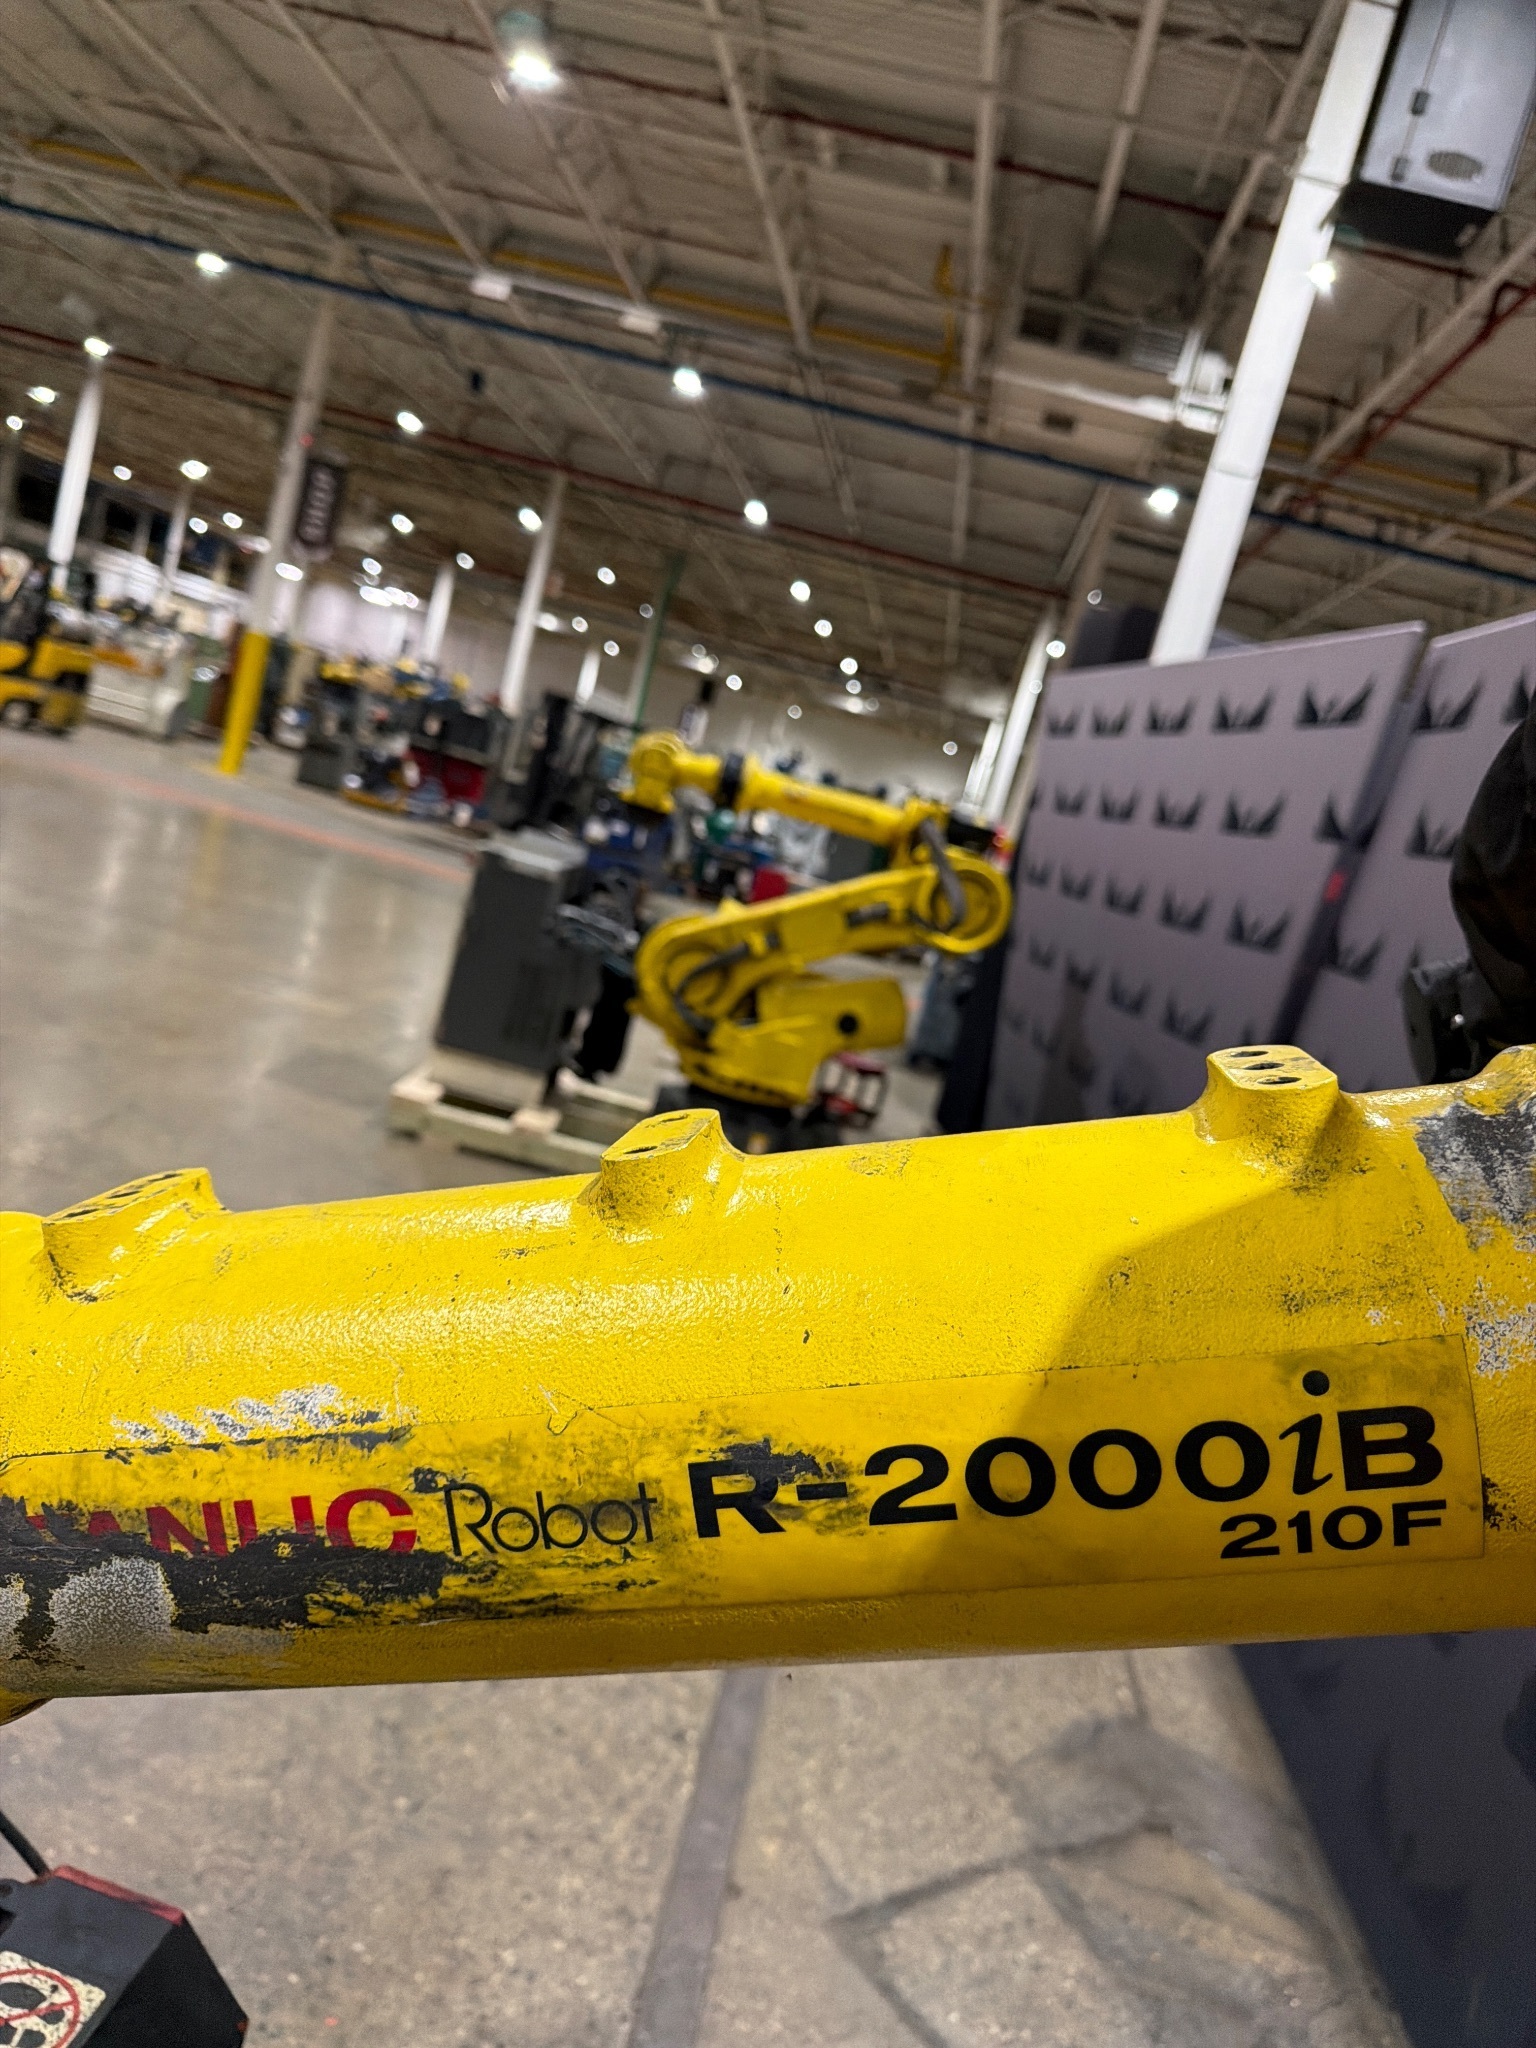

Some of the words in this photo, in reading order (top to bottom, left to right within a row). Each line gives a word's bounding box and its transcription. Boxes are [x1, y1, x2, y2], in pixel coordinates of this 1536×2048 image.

[443, 1481, 658, 1557] Robot
[687, 1369, 1443, 1539] R-2000iB
[1219, 1498, 1447, 1559] 210F
